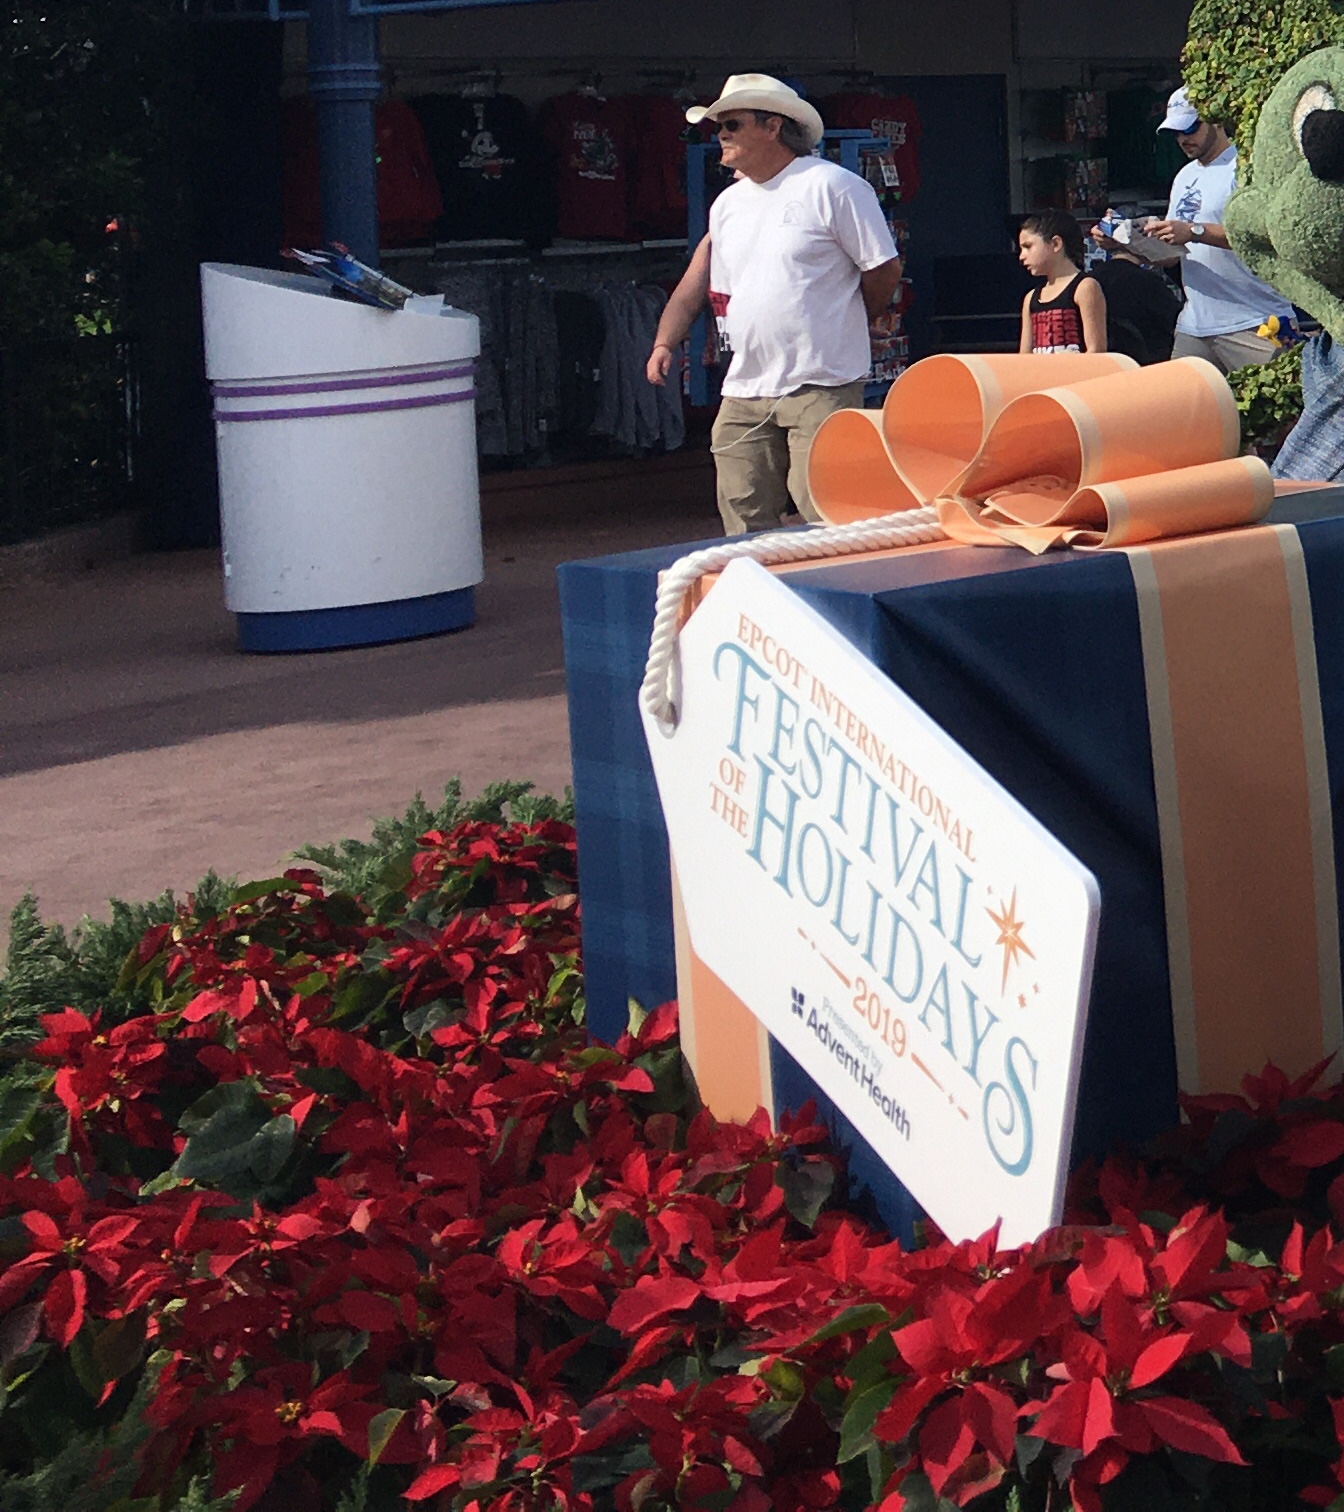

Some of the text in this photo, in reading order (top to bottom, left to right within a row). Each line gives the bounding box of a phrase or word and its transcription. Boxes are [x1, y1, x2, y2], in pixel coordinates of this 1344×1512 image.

[719, 758, 746, 795] OF
[737, 612, 976, 863] EPCOT INTERNATIONAL
[709, 782, 749, 838] THE
[712, 642, 981, 968] FESTIVAL
[745, 753, 1038, 1176] HOLIDAYS
[853, 977, 906, 1057] 2019
[806, 1008, 911, 1141] AdventHealth
[822, 996, 884, 1078] Presented by
